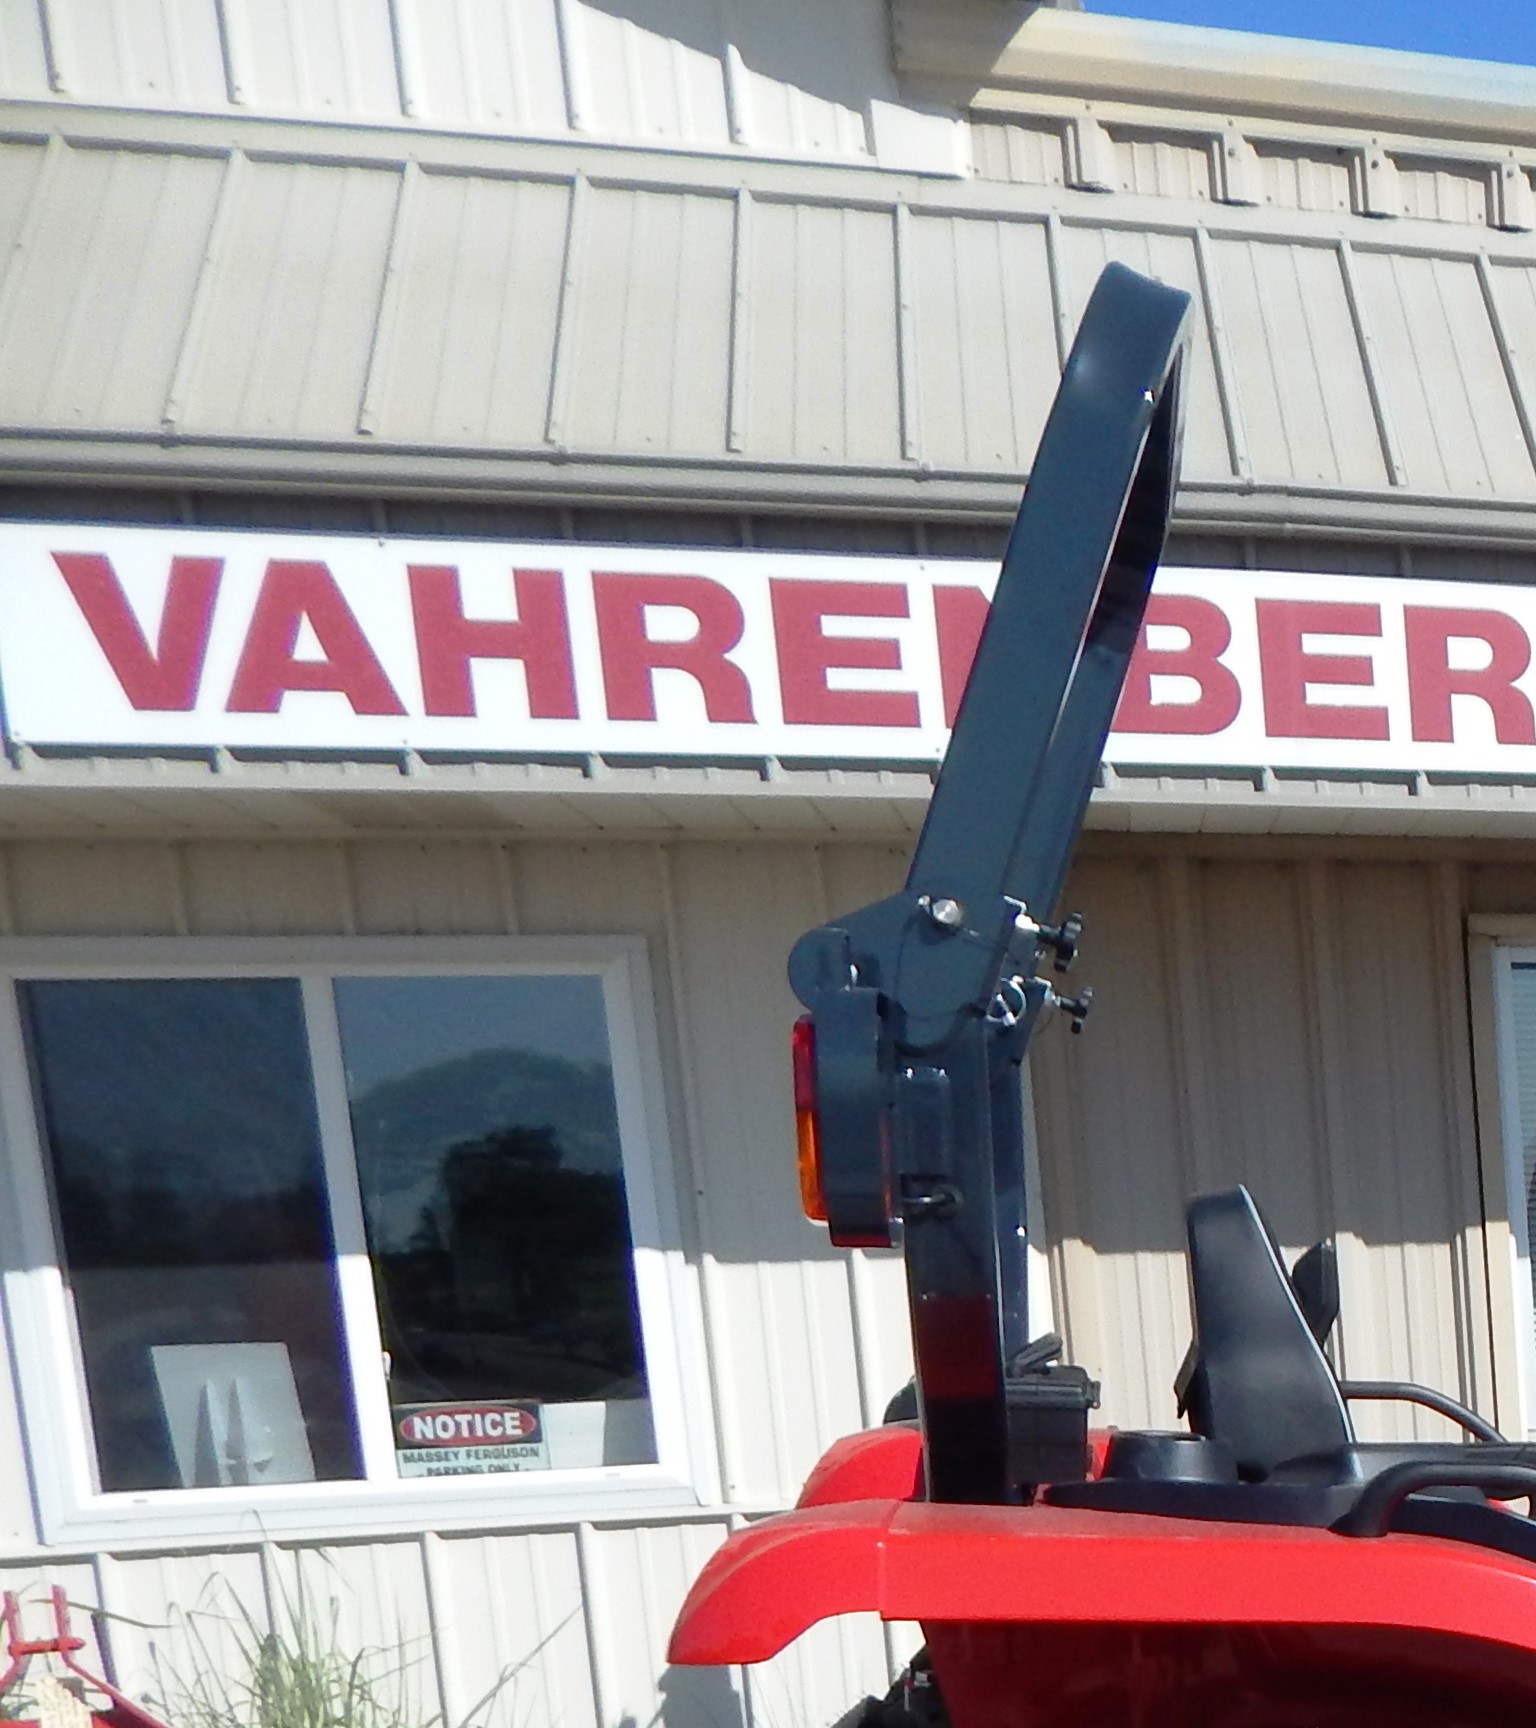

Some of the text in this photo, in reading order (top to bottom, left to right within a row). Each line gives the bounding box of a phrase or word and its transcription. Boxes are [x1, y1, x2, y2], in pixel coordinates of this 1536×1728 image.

[413, 1411, 523, 1439] NOTICE
[402, 1446, 540, 1463] MASSEY FERGUSON
